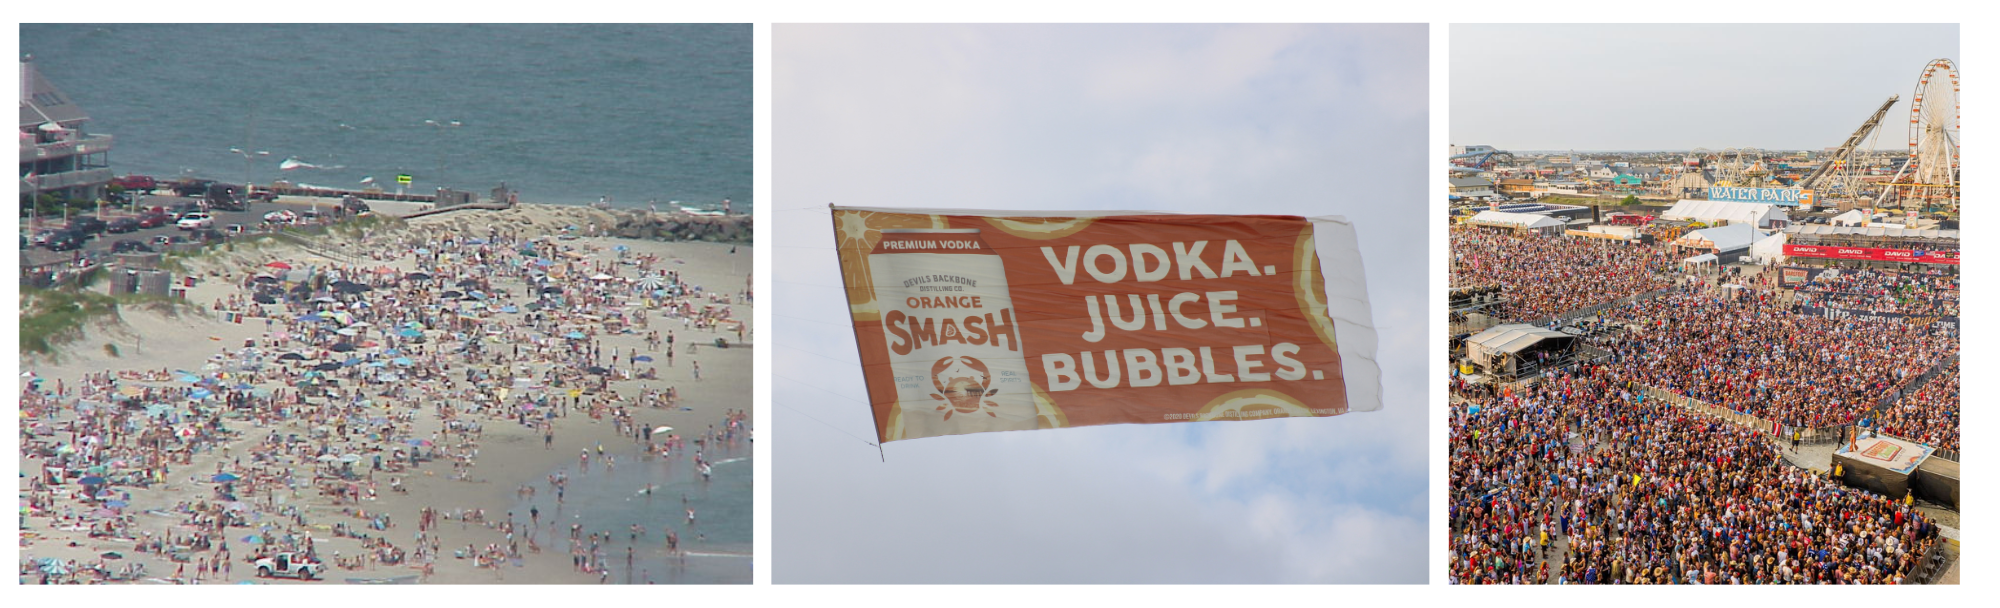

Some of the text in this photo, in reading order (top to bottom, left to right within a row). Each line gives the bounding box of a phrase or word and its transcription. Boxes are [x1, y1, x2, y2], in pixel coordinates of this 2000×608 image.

[1710, 187, 1801, 201] WATER PARK
[883, 240, 981, 250] PREMIUM VODKA
[1040, 239, 1276, 285] VODKA.
[903, 274, 977, 288] DEVILS BACKBONE
[906, 295, 983, 309] ORANGE
[1081, 290, 1262, 343] JUICE.
[885, 308, 1018, 356] SMASH
[1041, 342, 1325, 392] BUBBLES.
[893, 375, 914, 383] READY
